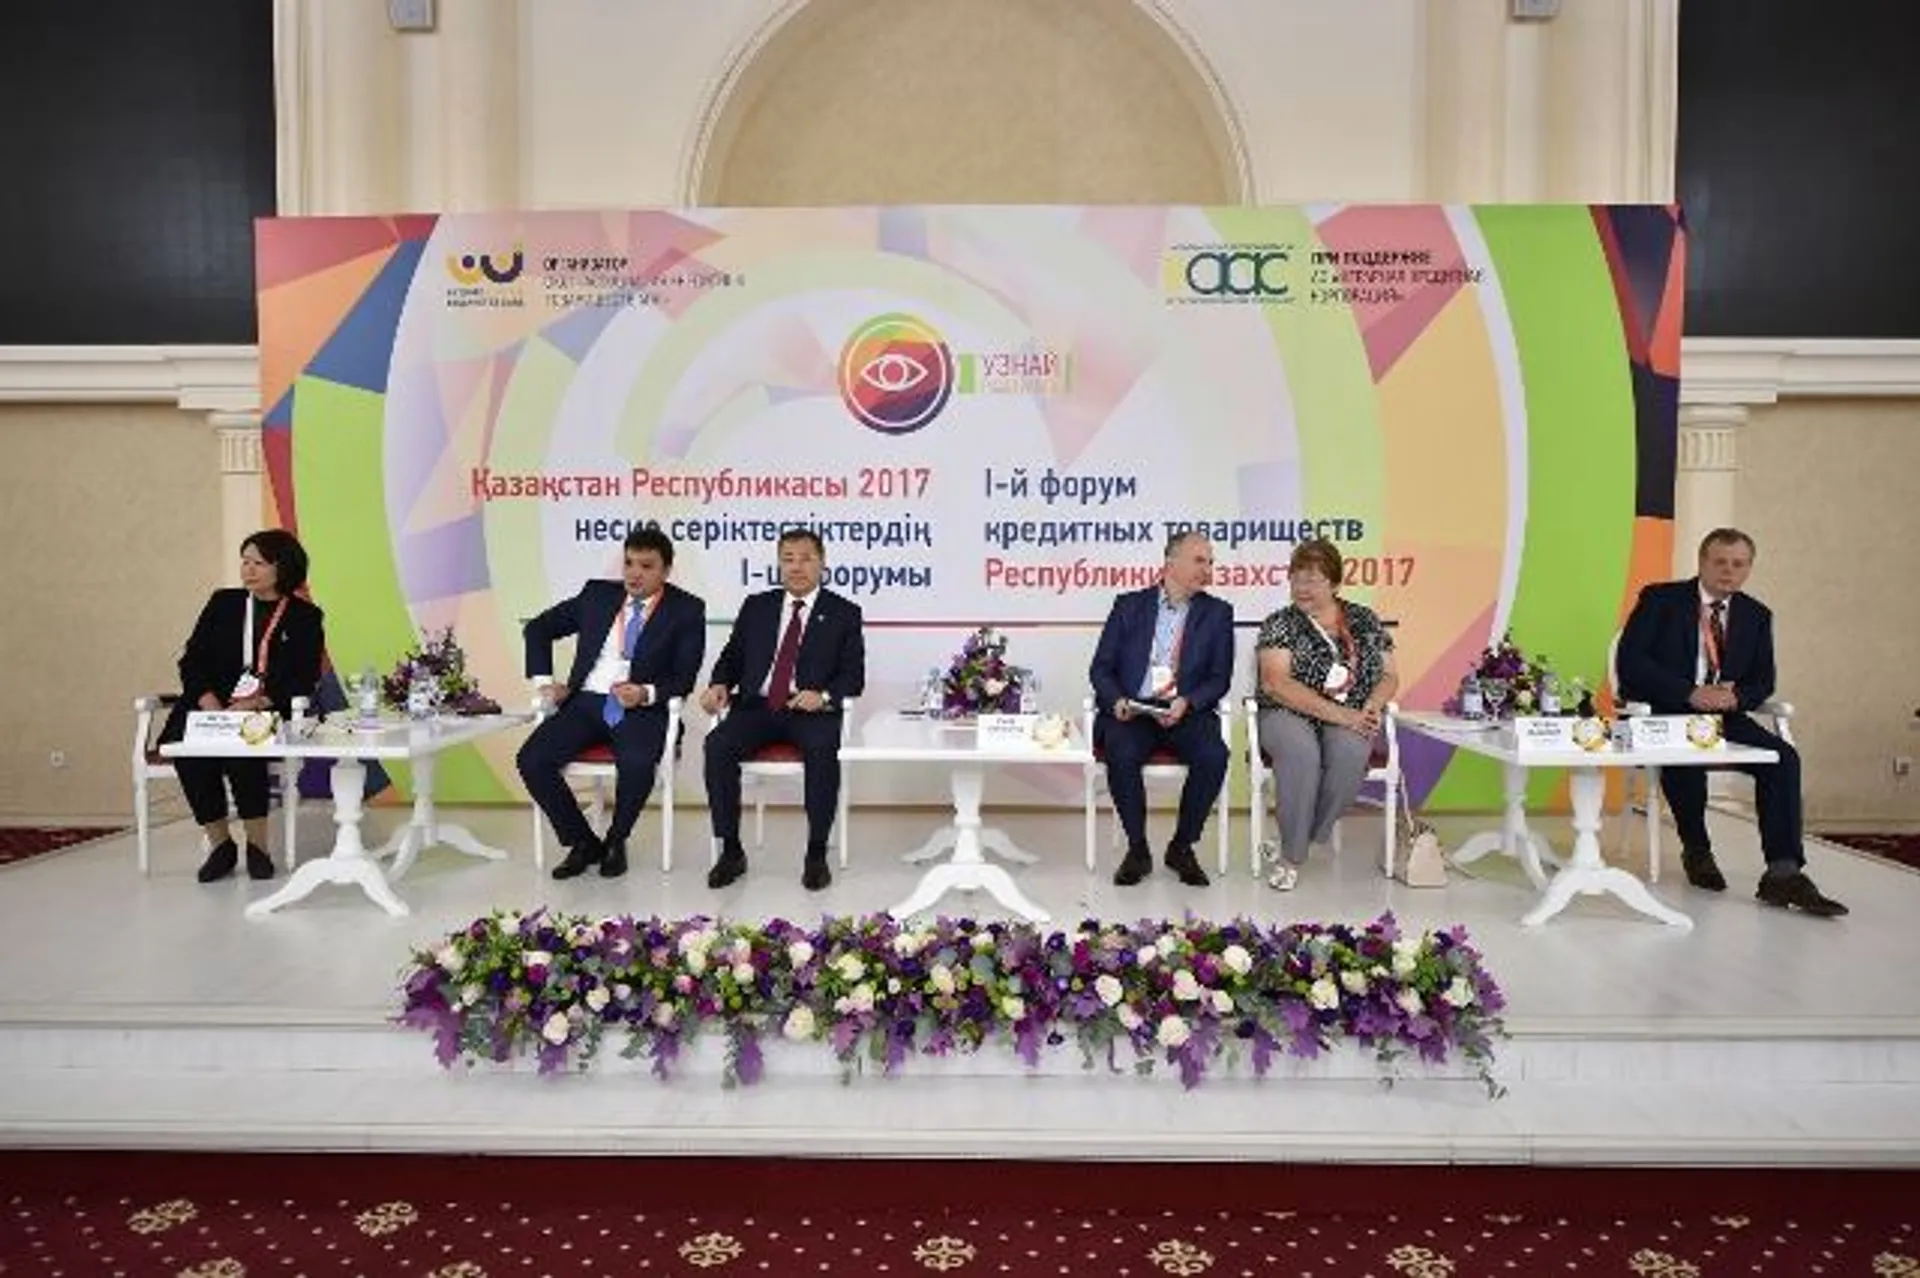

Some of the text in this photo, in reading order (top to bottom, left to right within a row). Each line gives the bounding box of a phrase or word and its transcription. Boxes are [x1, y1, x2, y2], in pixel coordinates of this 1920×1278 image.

[983, 352, 1058, 377] УЗНАЙ
[471, 467, 931, 504] Қазақстан Республикасы 2017
[1040, 471, 1136, 505] форум
[984, 518, 1153, 550] кредитных
[1343, 557, 1415, 586] 2017
